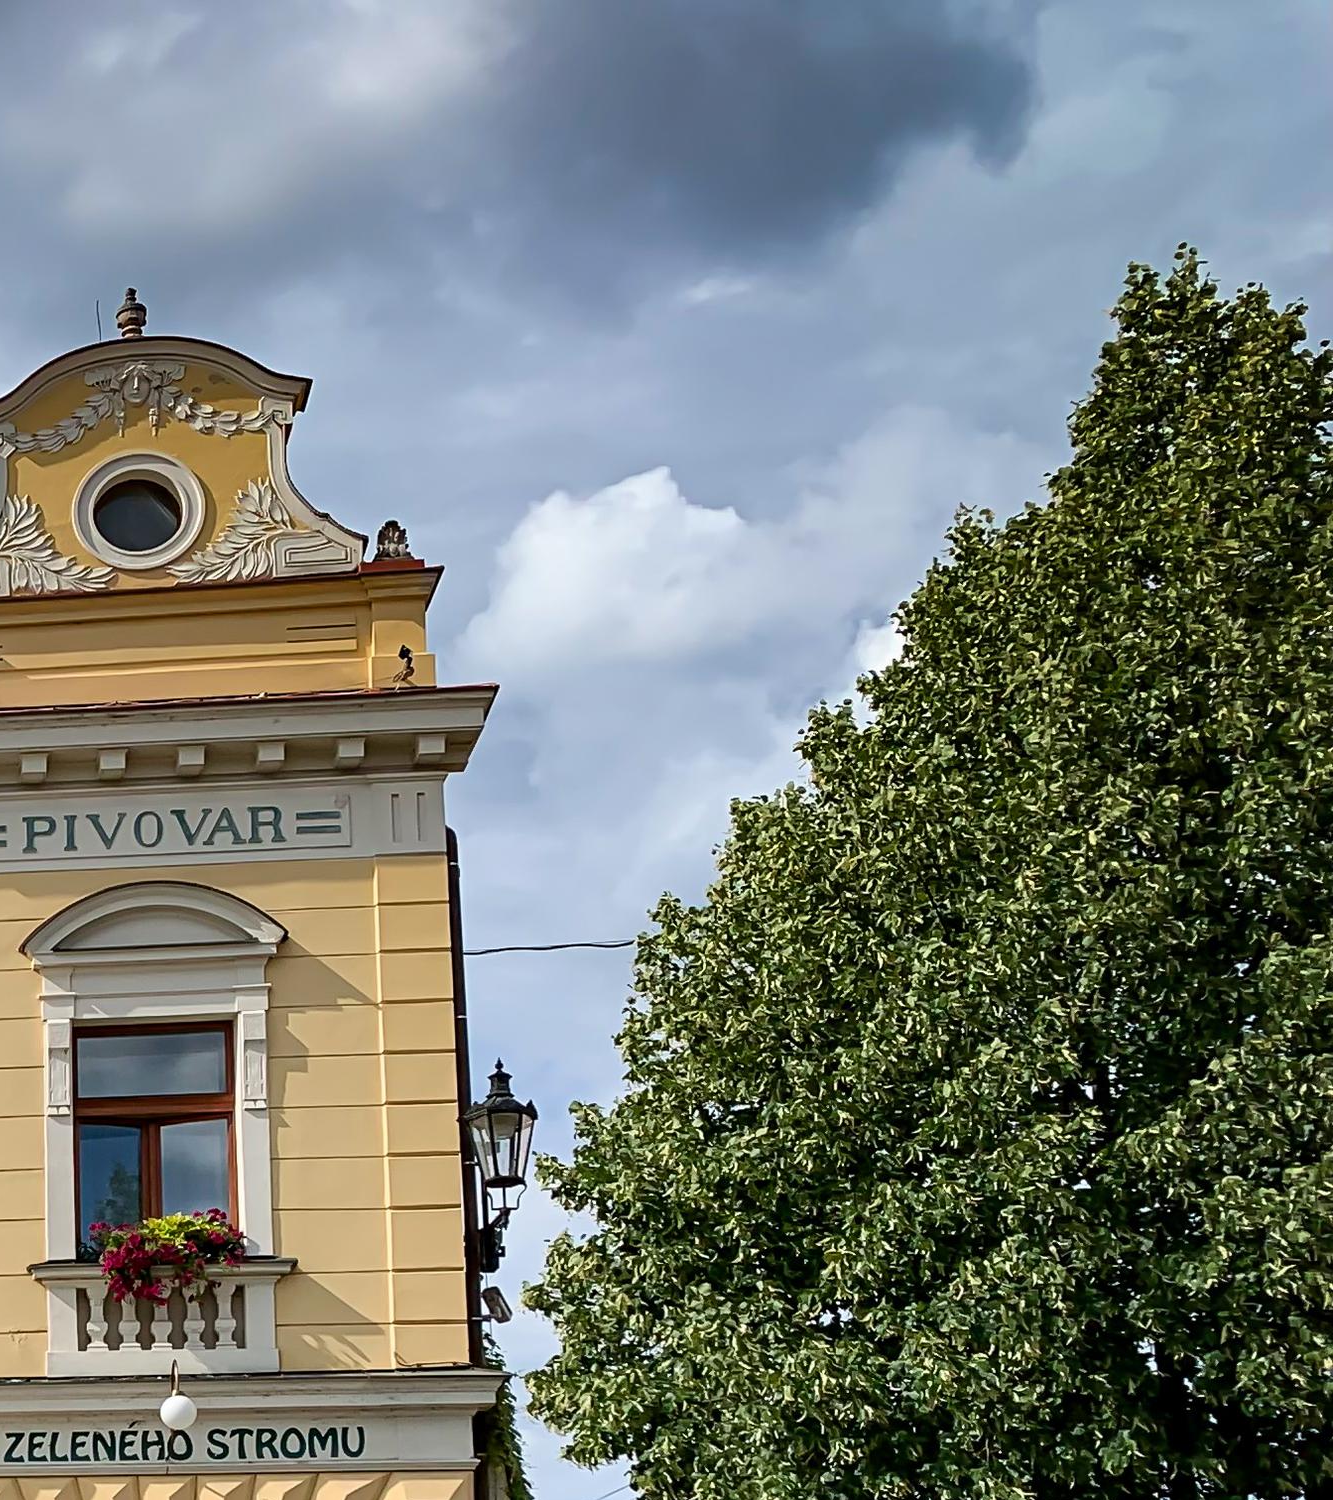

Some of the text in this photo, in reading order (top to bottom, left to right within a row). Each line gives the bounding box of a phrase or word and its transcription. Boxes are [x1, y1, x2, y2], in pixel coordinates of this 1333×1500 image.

[21, 805, 287, 854] PIVOVAR
[4, 1421, 193, 1463] ZELENÉHO
[206, 1425, 366, 1460] STROMU
